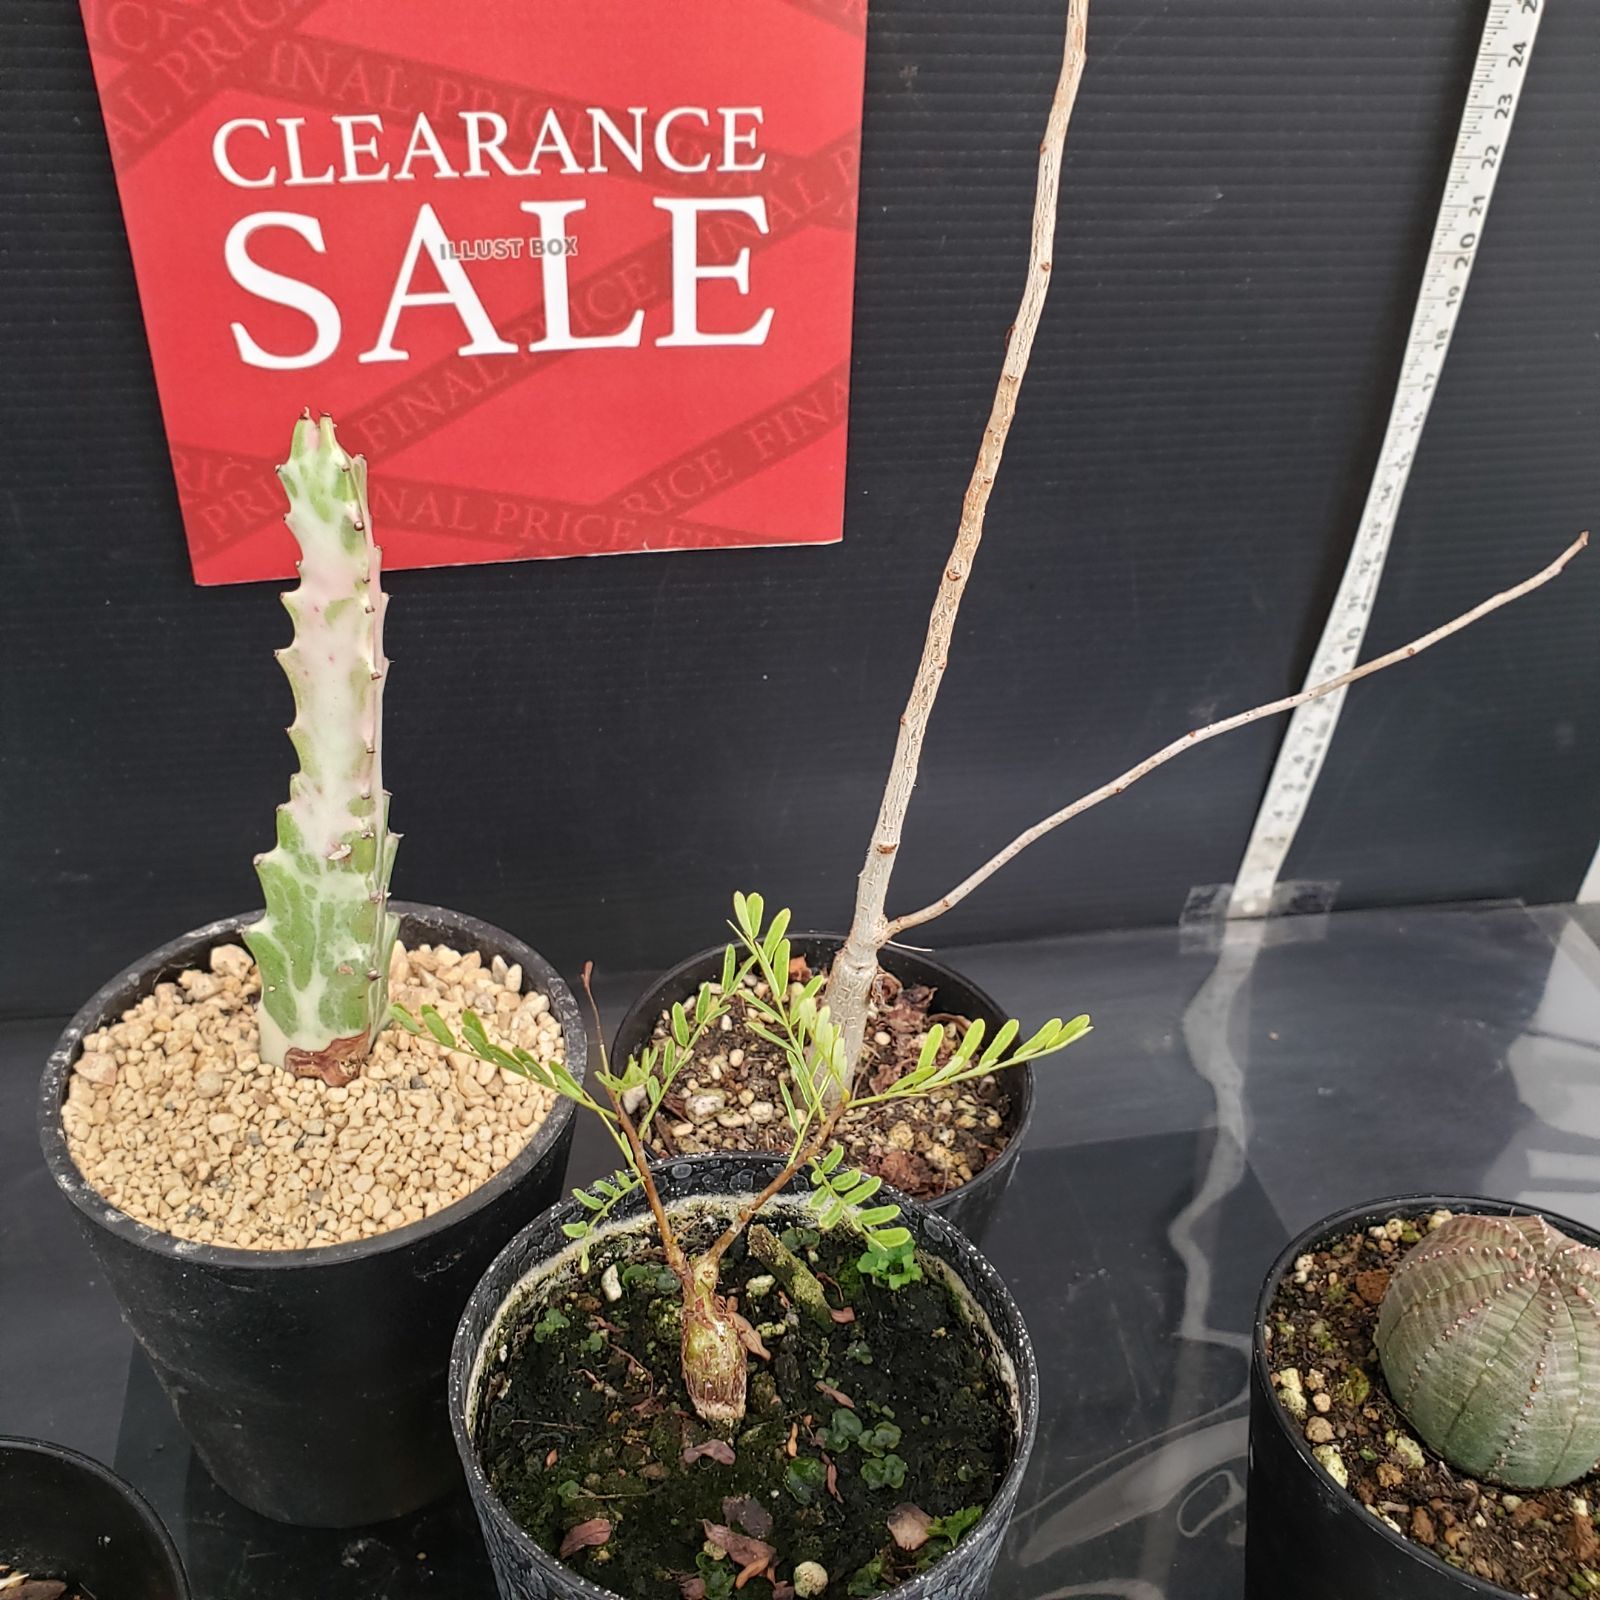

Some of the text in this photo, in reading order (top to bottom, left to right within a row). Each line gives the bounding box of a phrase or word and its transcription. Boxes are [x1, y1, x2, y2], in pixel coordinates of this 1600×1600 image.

[212, 106, 767, 190] CLEARANCE
[223, 196, 776, 371] SALE
[439, 236, 579, 262] ILLUST BOX
[508, 263, 658, 363] PICE
[1342, 627, 1361, 655] 10
[1422, 372, 1435, 393] 17
[1434, 328, 1449, 351] 18
[1445, 285, 1461, 308] 19
[1453, 232, 1477, 270] 20
[1468, 195, 1486, 219] 21
[1481, 144, 1501, 170] 22
[1494, 93, 1513, 120] 23
[1507, 41, 1528, 68] 24
[374, 482, 477, 529] NAL
[622, 447, 735, 516] RICE
